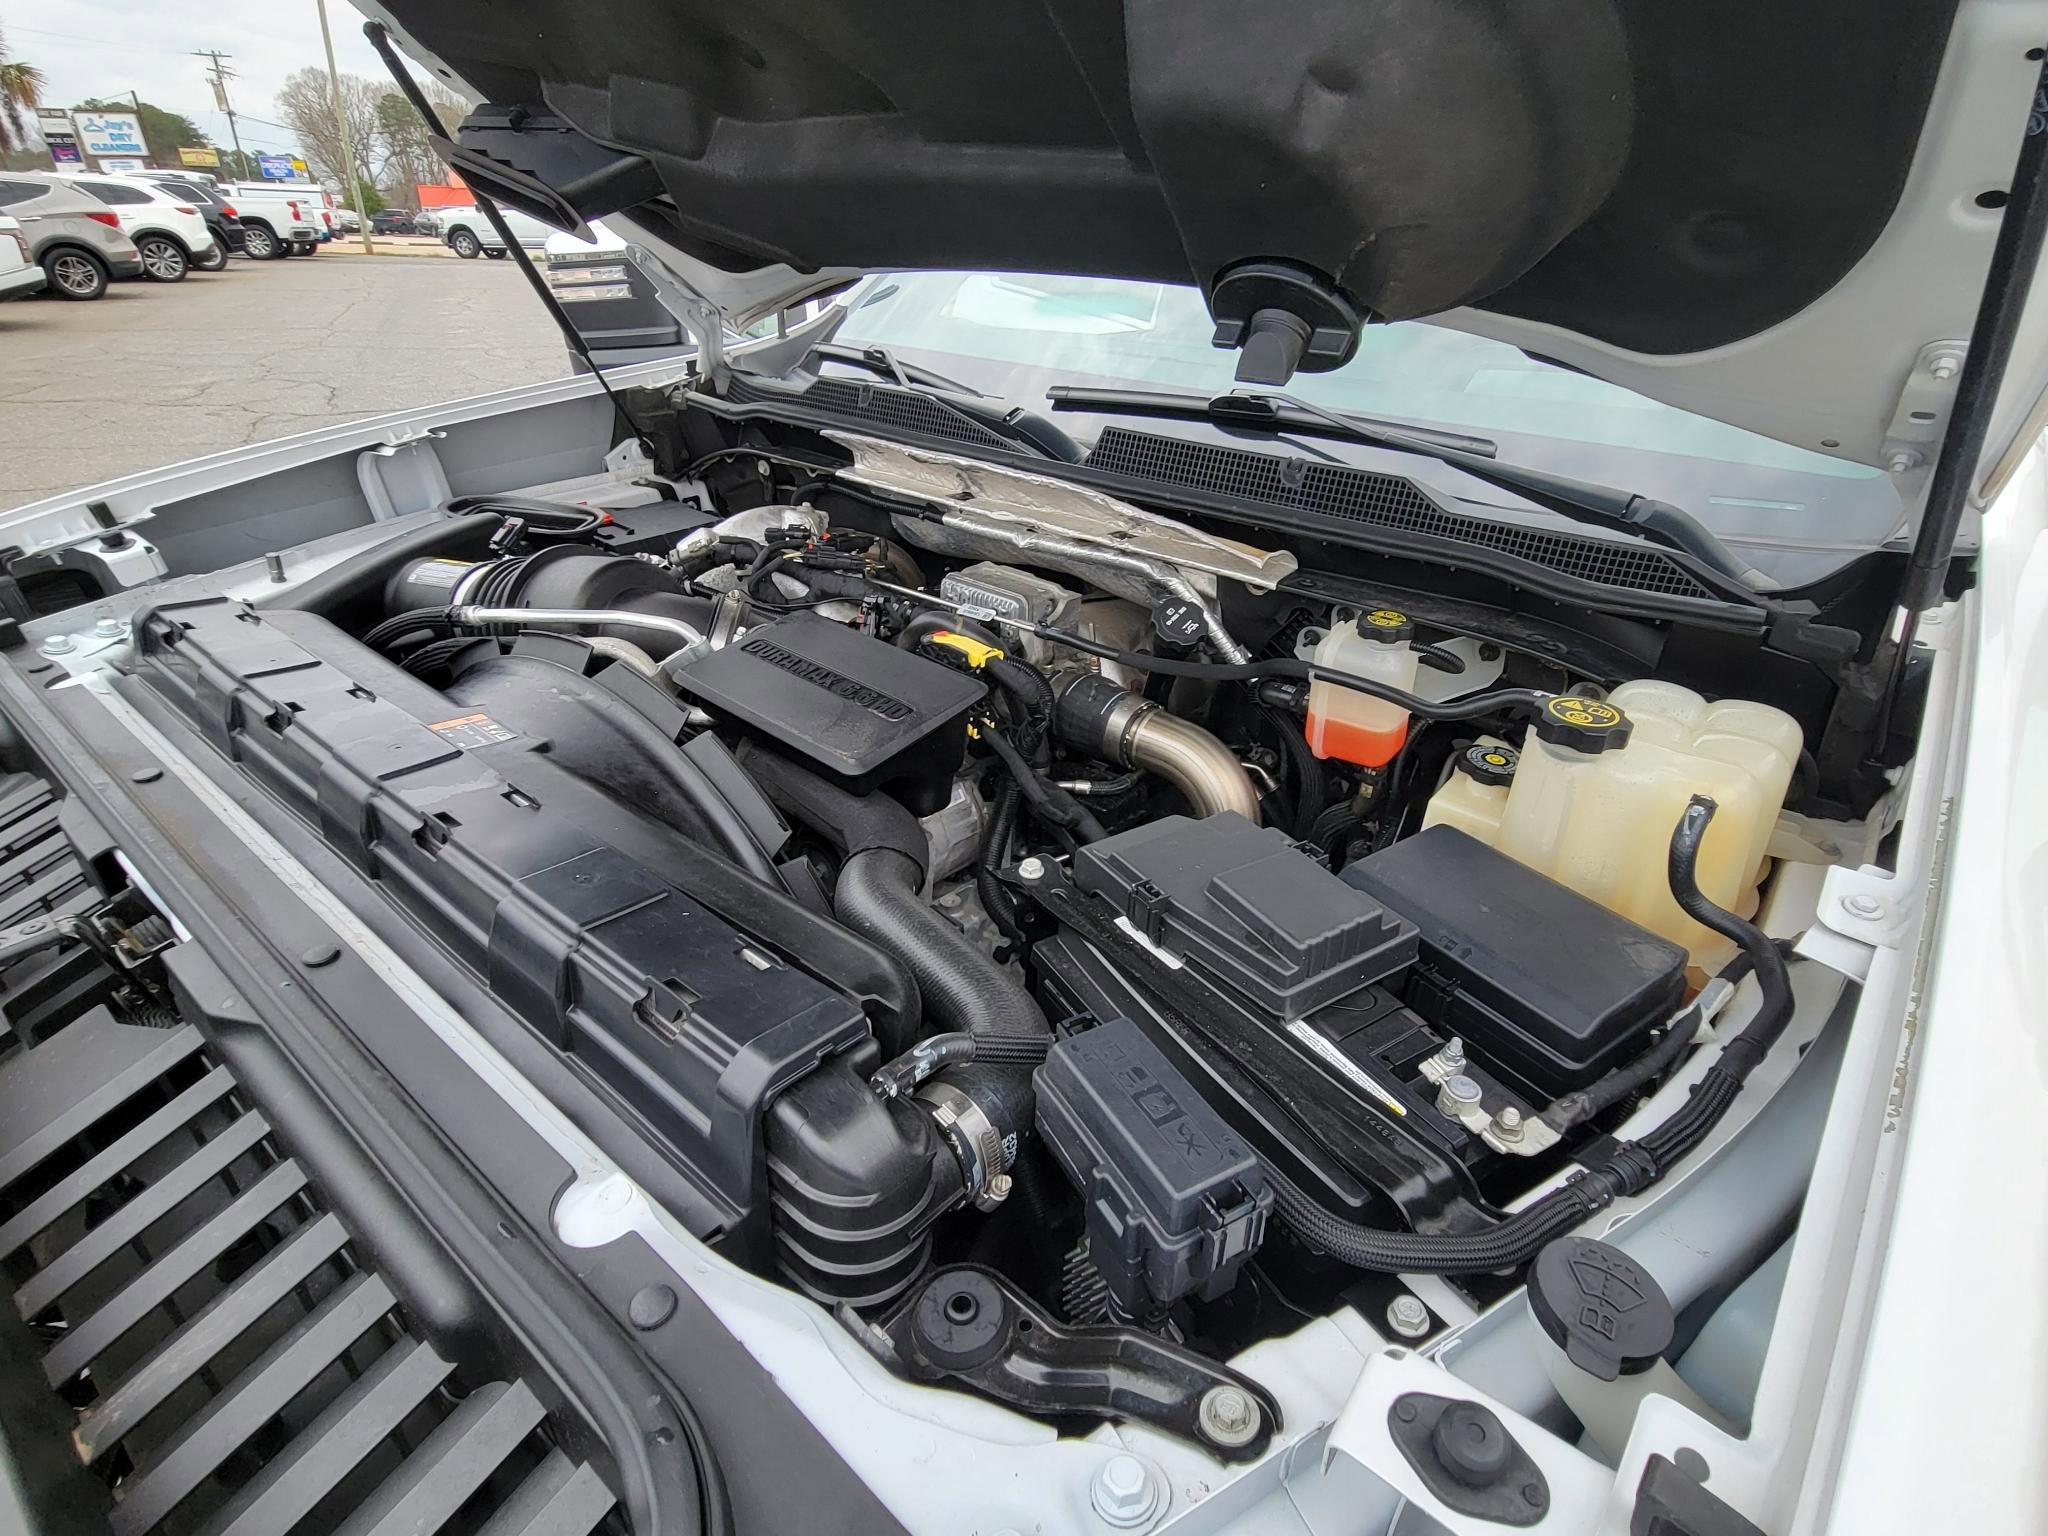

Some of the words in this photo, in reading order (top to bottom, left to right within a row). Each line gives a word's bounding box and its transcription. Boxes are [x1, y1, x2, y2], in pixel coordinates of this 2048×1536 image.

[109, 132, 132, 142] DRY
[90, 142, 142, 152] CLEANERS
[741, 640, 844, 692] DURAMAX
